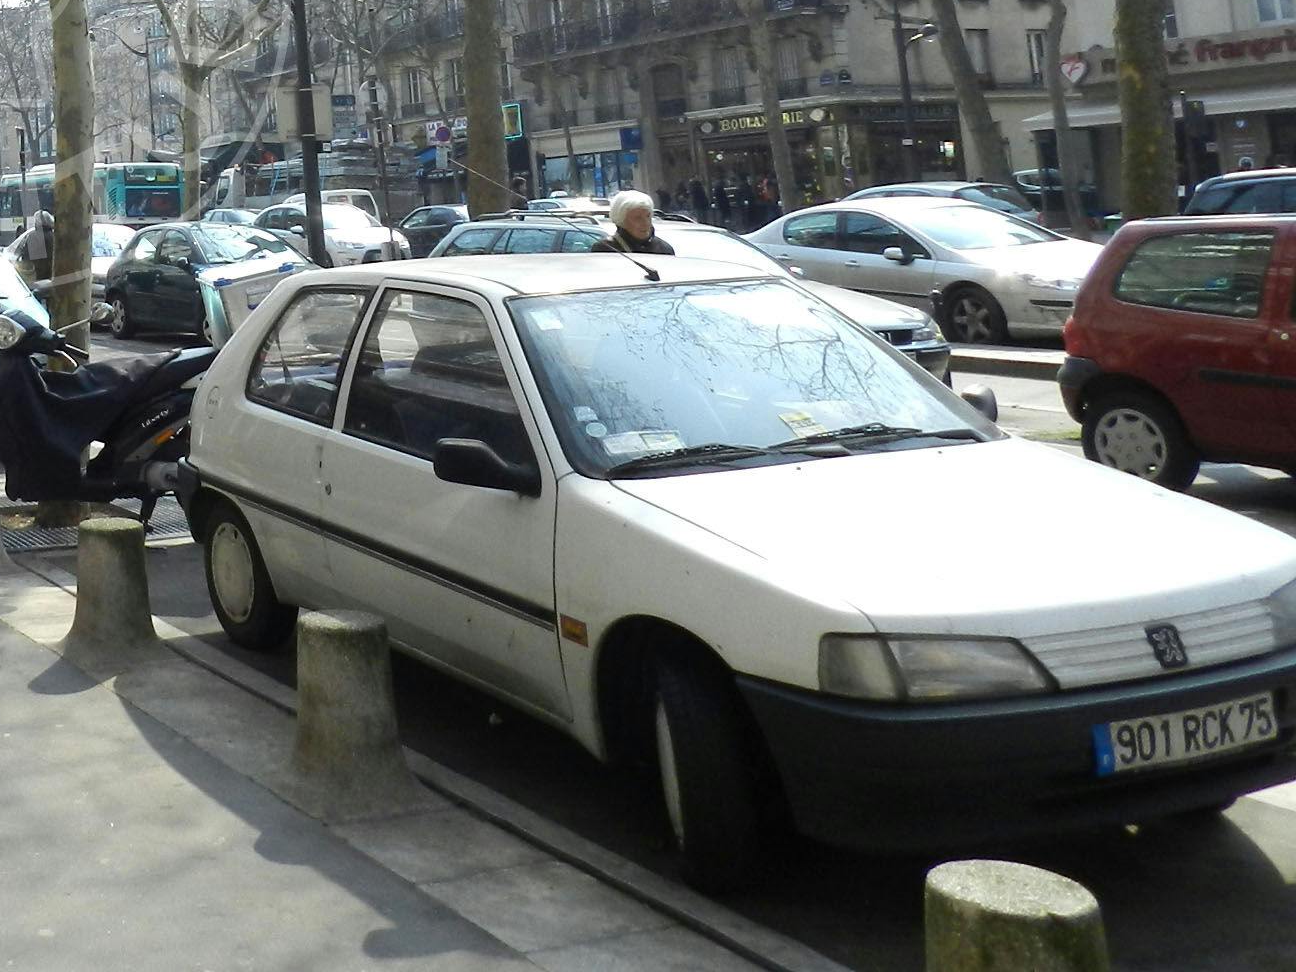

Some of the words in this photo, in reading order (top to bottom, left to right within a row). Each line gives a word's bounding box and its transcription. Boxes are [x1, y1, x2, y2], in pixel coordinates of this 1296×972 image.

[719, 111, 804, 132] BOULANRIE
[1117, 721, 1172, 764] 901
[1182, 707, 1236, 752] RCK
[1239, 697, 1272, 740] 75
